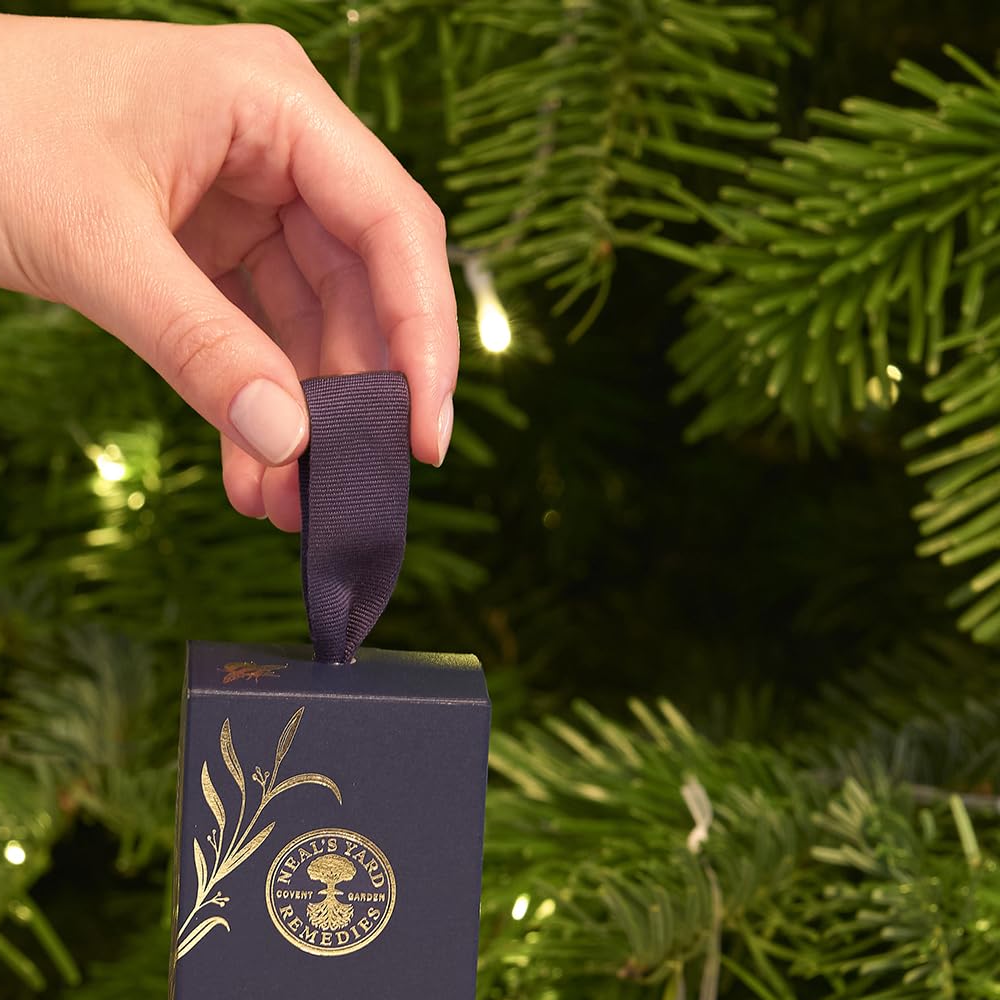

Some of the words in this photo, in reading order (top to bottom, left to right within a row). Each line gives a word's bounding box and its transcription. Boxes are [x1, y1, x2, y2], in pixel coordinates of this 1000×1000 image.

[277, 838, 338, 885] NEAL'S
[344, 841, 385, 888] YARD
[276, 890, 313, 899] COVENT
[348, 892, 385, 902] GARDEN
[279, 904, 381, 946] REMEDIES
